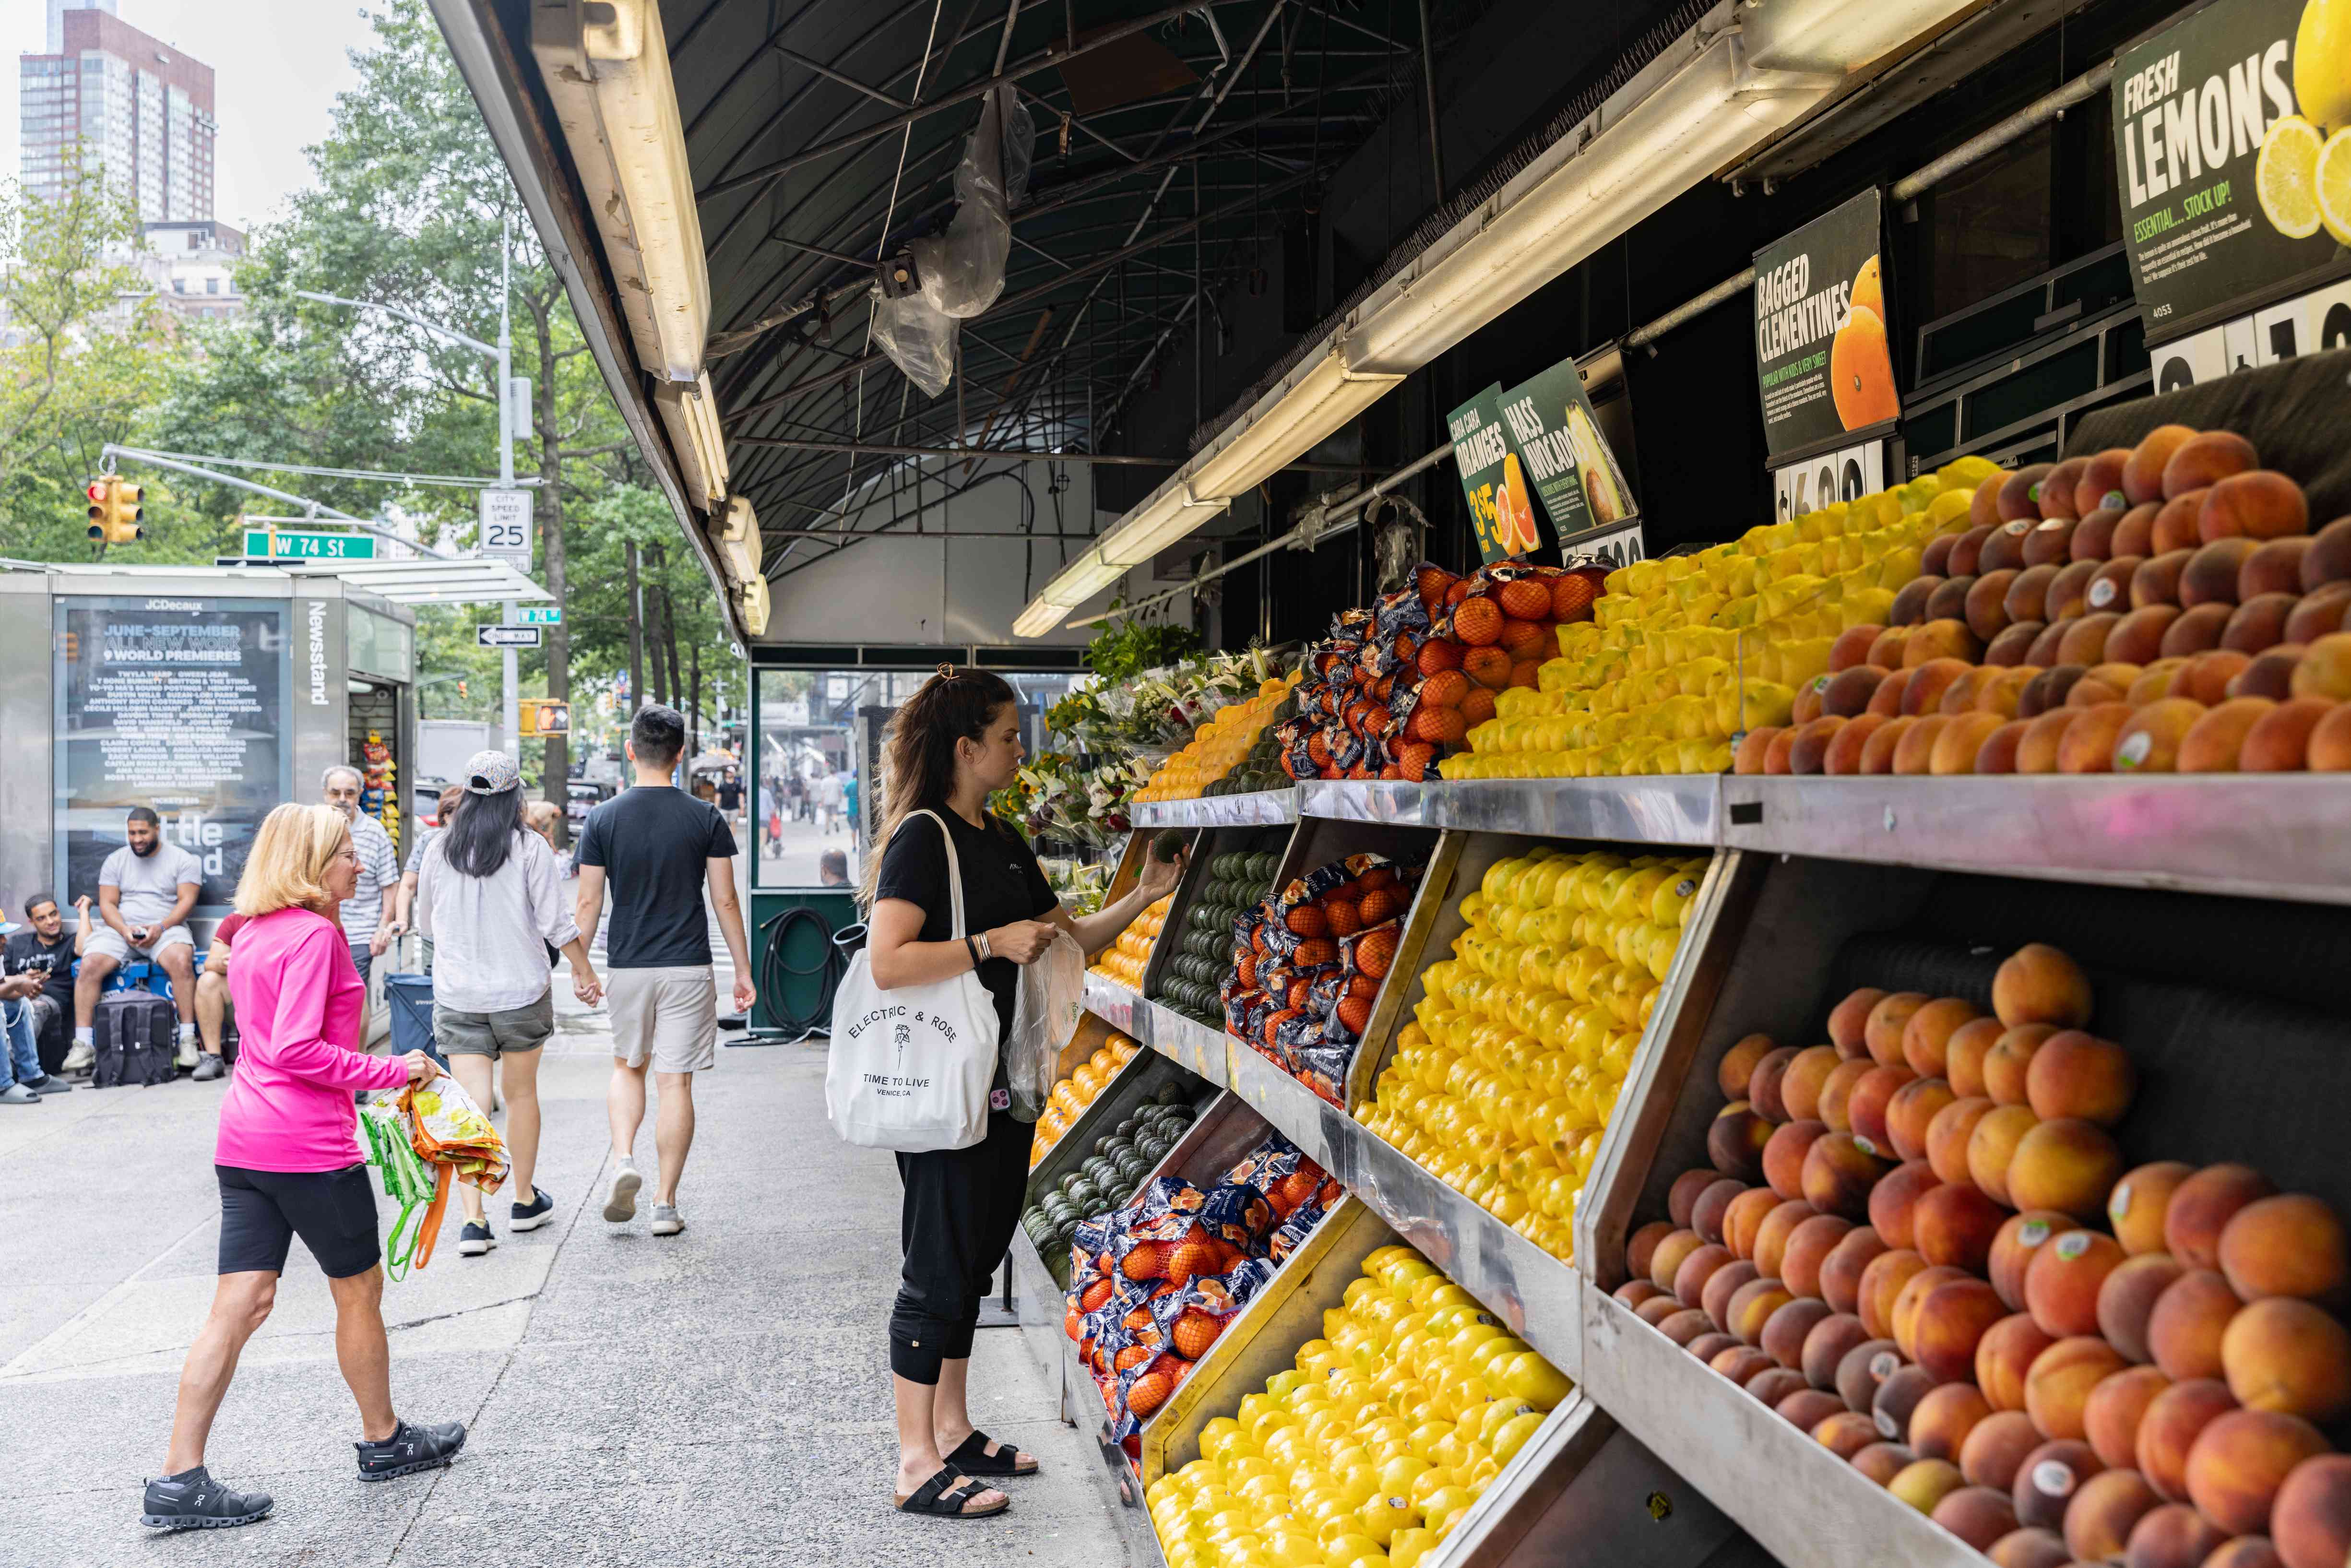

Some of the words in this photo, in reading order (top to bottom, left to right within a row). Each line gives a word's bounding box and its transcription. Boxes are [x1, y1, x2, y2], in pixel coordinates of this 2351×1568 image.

[2124, 50, 2180, 119] FRESH
[2125, 40, 2294, 208] LEMONS
[2184, 188, 2214, 220] STOCK
[2213, 181, 2232, 207] UP!
[1758, 253, 1809, 320] BAGGED
[1759, 281, 1851, 363] CLEMENTINES
[2153, 304, 2172, 318] 4053
[1763, 370, 1779, 389] POPULAR
[1778, 365, 1790, 382] WITH
[1789, 362, 1799, 379] KIDS
[1798, 361, 1803, 373] &
[1802, 356, 1813, 373] VERY
[1812, 351, 1827, 368] SWEET
[1450, 417, 1464, 442] CARA
[1464, 408, 1481, 433] CARA
[1505, 396, 1544, 444] HASS
[1456, 421, 1507, 480] ORANGES
[1470, 490, 1485, 536] 3
[276, 537, 292, 554] W
[300, 538, 320, 556] 74
[327, 539, 345, 557] St
[489, 525, 523, 545] 25
[145, 599, 202, 611] JCDecaux
[519, 610, 529, 622] W
[534, 610, 546, 622] 74
[104, 650, 114, 661] 9
[114, 650, 164, 661] WORLD
[165, 650, 241, 662] PREMIERES
[105, 637, 139, 650] ALL
[142, 637, 184, 650] NEW
[188, 637, 241, 650] WORK
[309, 601, 329, 705] Newsstand
[126, 816, 223, 846] ttle
[848, 1006, 906, 1039] ELECTRIC
[915, 1011, 924, 1022] &
[931, 1016, 956, 1044] ROSE
[864, 1074, 889, 1085] TIME
[893, 1078, 902, 1086] TO
[906, 1079, 929, 1087] LIVE
[1200, 1190, 1221, 1216] Mandarins
